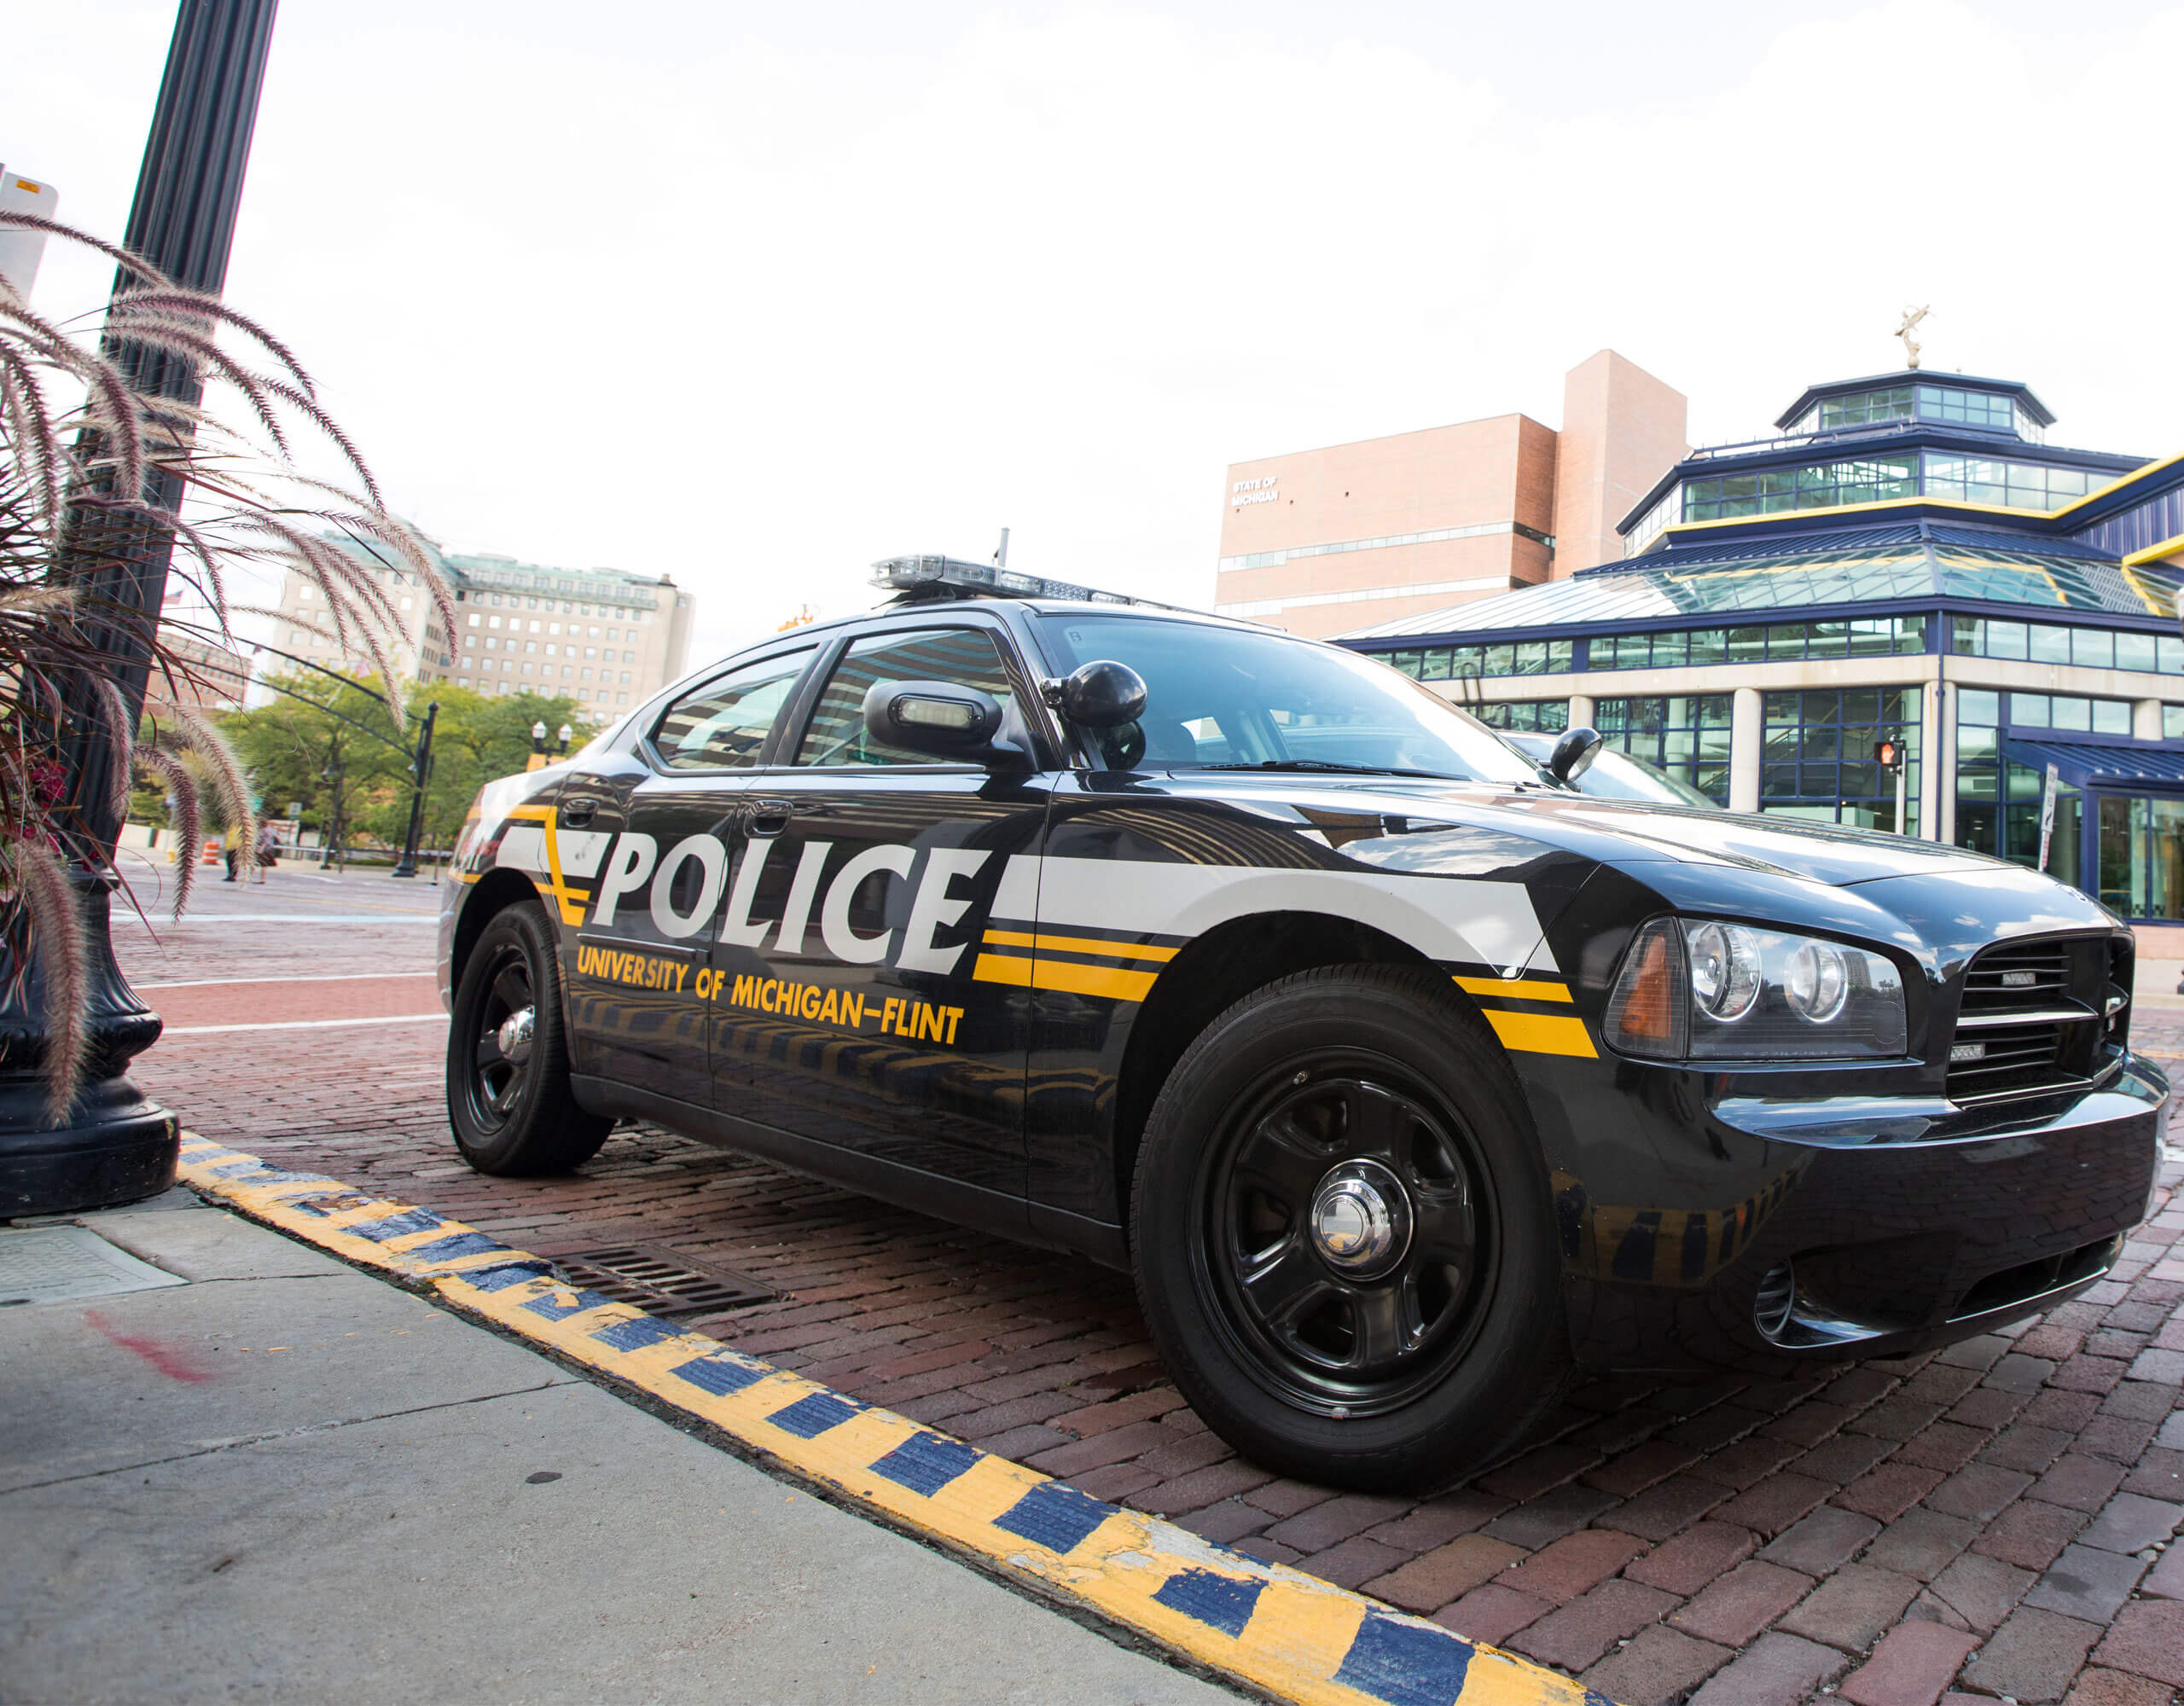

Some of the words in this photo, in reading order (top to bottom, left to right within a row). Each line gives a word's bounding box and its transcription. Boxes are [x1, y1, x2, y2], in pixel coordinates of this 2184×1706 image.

[1231, 490, 1279, 507] MICHIGAN
[1234, 478, 1262, 493] STATE
[1263, 475, 1278, 489] OF
[591, 833, 993, 974] POLICE
[577, 945, 689, 994] UNIVERSITY
[695, 967, 725, 1001] OF
